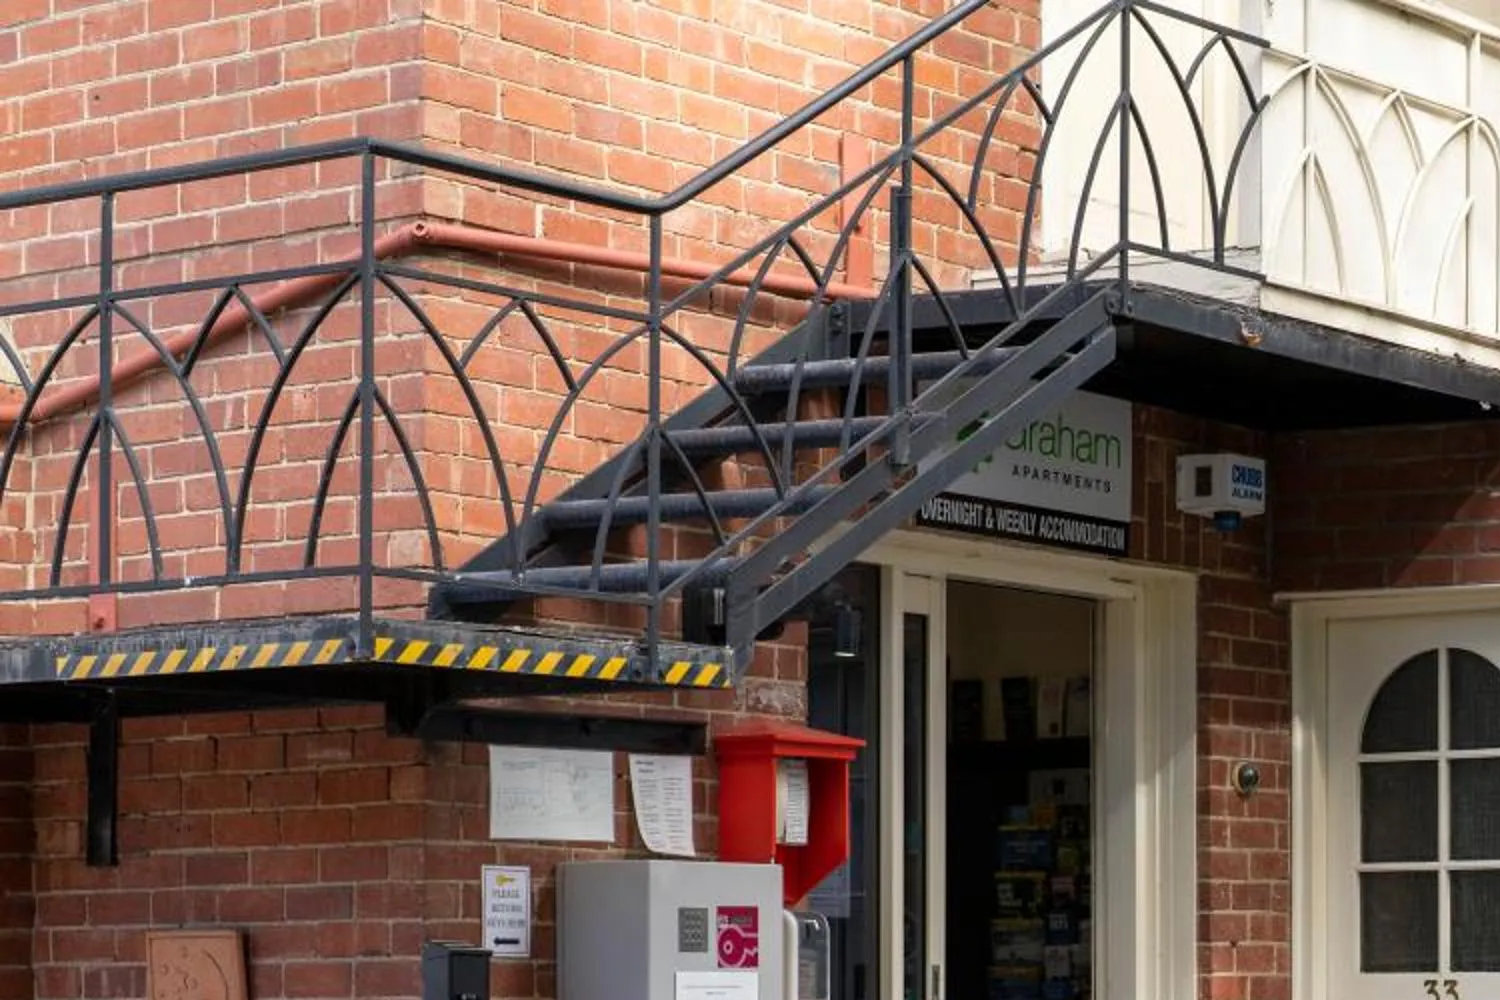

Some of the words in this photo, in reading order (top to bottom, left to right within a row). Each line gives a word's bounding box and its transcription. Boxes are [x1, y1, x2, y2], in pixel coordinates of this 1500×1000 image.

[1011, 465, 1111, 493] APARTMENTS
[1232, 487, 1262, 501] ALARM
[921, 497, 984, 527] OVERNIGHT
[985, 506, 995, 528] &
[995, 509, 1037, 535] WEEKLY
[1039, 517, 1125, 550] ACCOMMODATION
